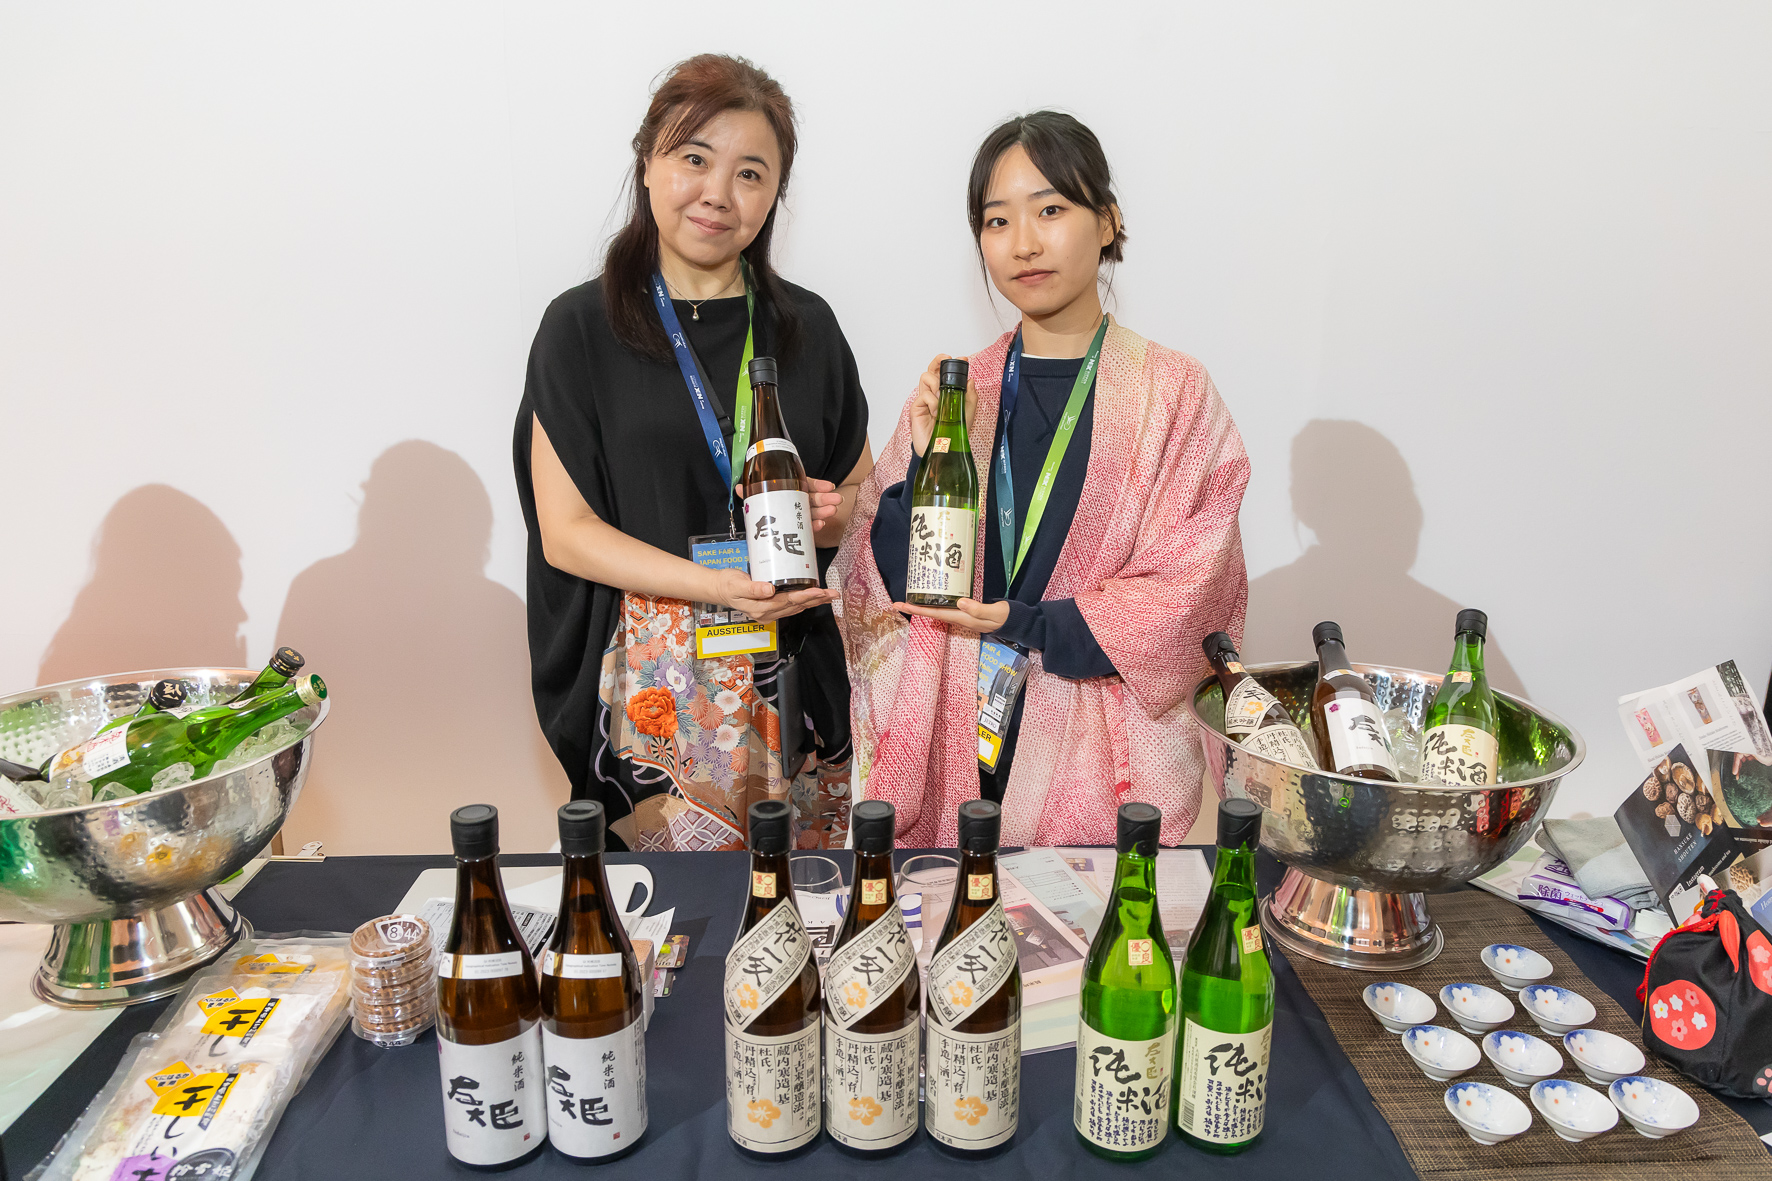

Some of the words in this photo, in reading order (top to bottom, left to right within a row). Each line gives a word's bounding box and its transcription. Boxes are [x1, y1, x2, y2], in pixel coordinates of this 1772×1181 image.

[706, 624, 765, 636] AUSSTELLER
[982, 642, 996, 653] FAIR
[981, 652, 998, 665] FOOD
[999, 662, 1017, 677] SHOW
[1678, 840, 1697, 862] SHOUTEN
[1538, 884, 1562, 900] 除菌
[512, 1052, 525, 1092] 純米酒
[601, 1050, 616, 1090] 純米酒
